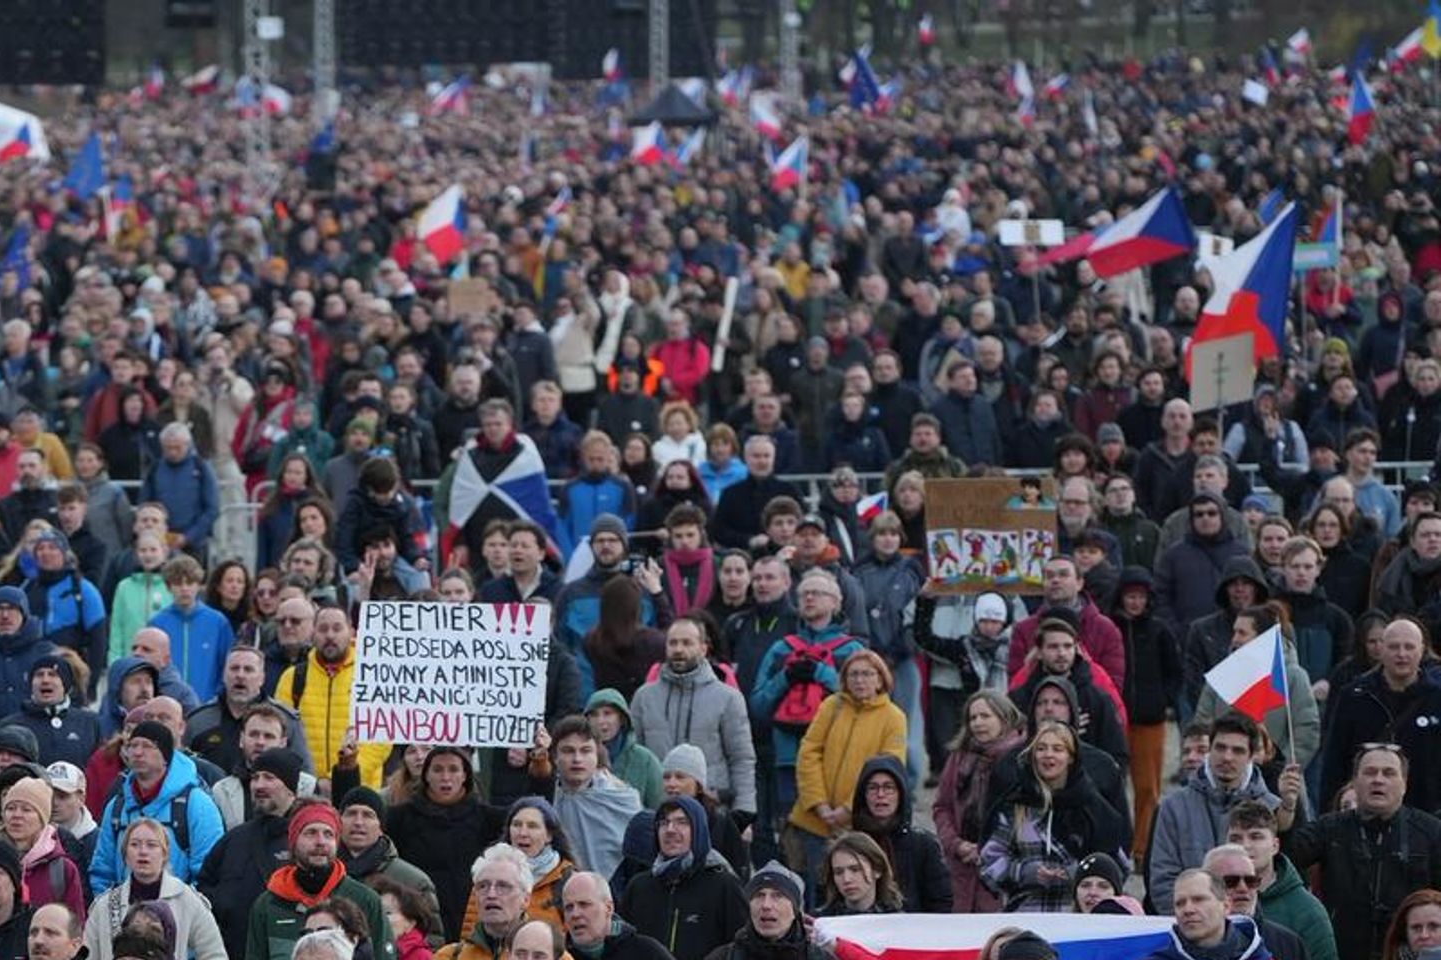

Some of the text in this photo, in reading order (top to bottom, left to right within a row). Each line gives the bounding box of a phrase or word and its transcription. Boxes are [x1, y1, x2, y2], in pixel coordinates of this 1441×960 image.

[362, 632, 469, 660] PŘEDSEDA
[433, 665, 448, 685] A
[452, 664, 538, 688] MINISTR
[476, 689, 522, 709] JSOU
[354, 706, 461, 744] HANBOU
